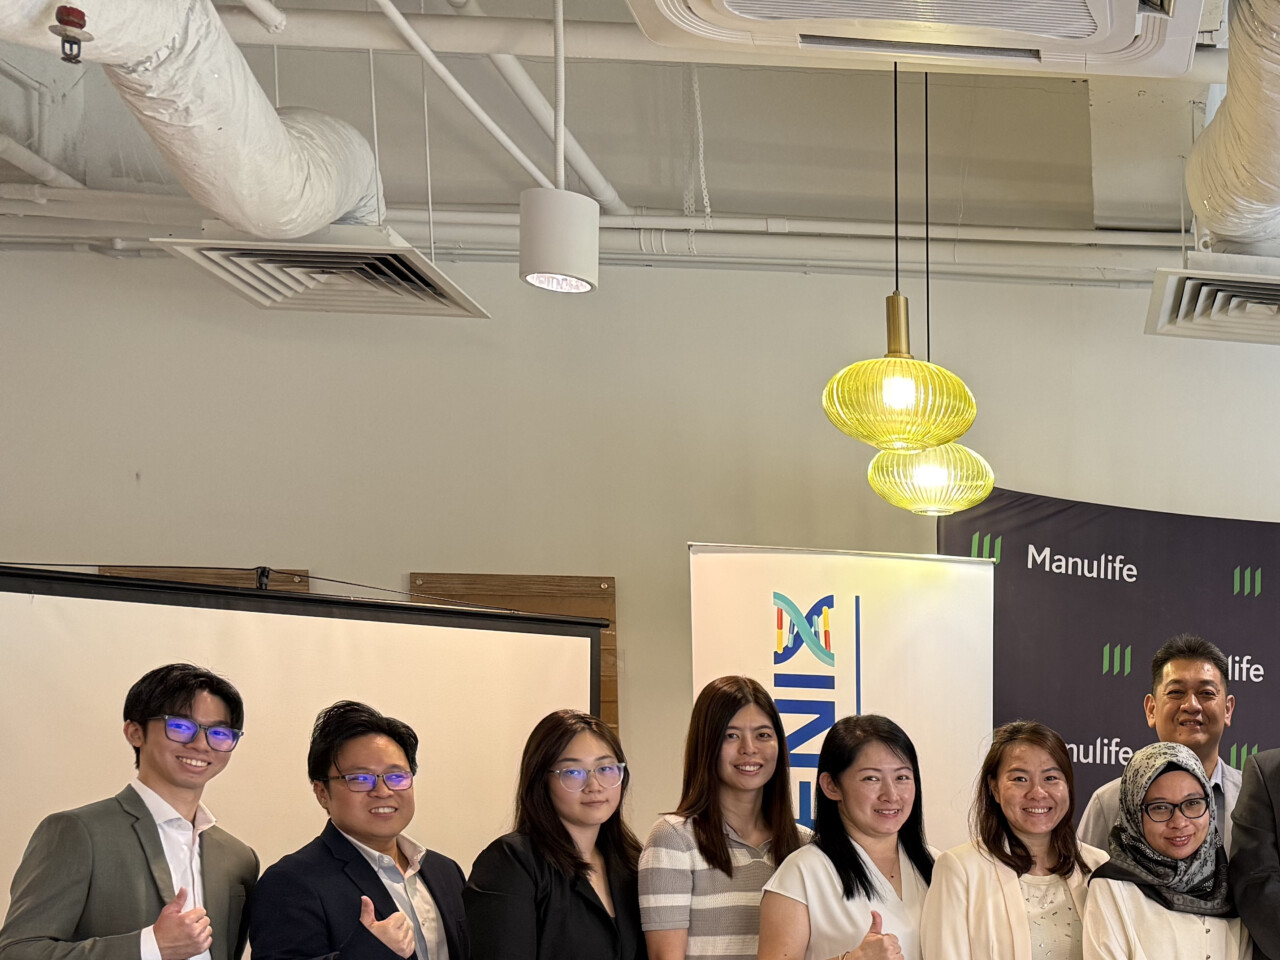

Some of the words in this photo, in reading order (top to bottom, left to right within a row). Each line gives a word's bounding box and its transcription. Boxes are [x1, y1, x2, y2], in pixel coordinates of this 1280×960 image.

[1027, 544, 1138, 582] Manulife
[1227, 654, 1265, 683] life
[1065, 736, 1134, 766] nulife
